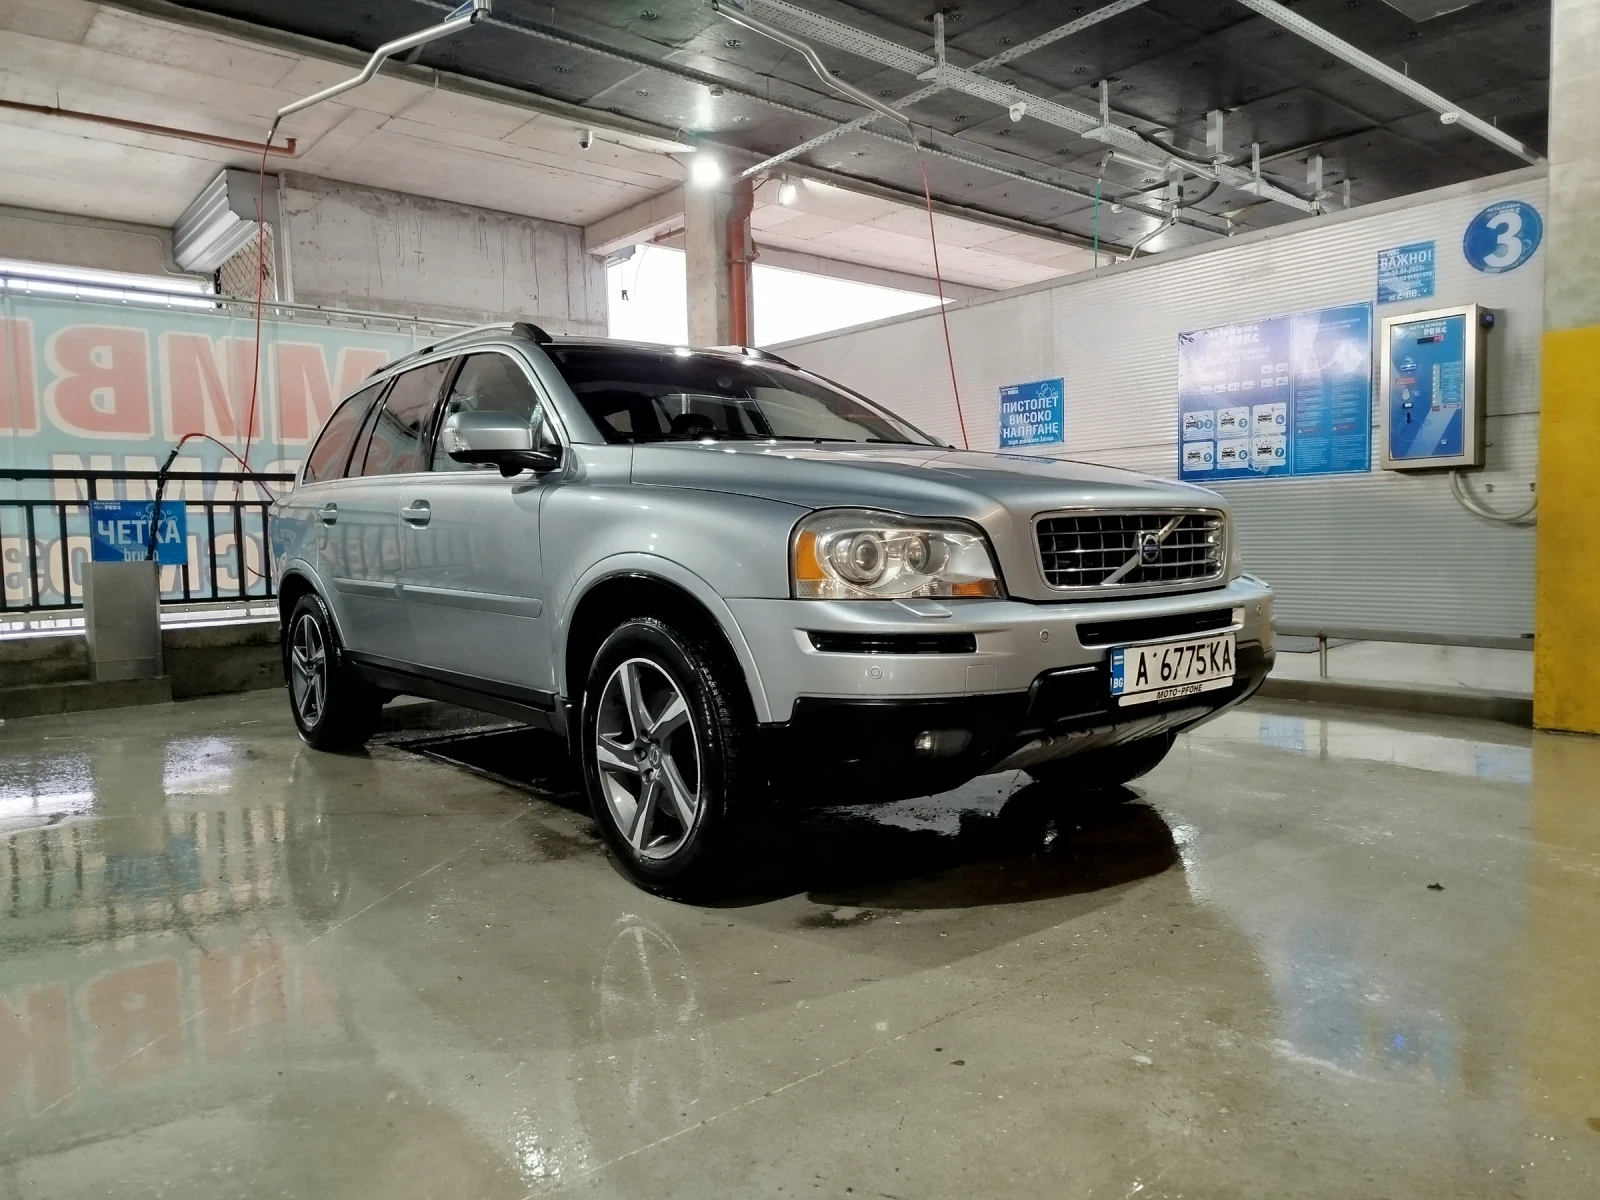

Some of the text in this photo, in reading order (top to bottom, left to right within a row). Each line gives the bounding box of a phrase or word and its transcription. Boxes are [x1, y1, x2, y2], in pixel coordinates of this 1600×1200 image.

[1483, 212, 1523, 267] 3
[1381, 250, 1432, 269] ВАЖНО!
[1397, 290, 1403, 300] 2
[1423, 326, 1447, 335] РЕКС
[1003, 396, 1059, 414] ПИСТОЛЕТ
[1009, 410, 1052, 425] ВИСОКО
[1003, 422, 1059, 439] НАЛЯГАНЕ
[97, 520, 181, 545] ЧЕТКА
[1135, 651, 1149, 686] A
[1113, 677, 1124, 688] BG
[1156, 684, 1203, 699] MOTO-PFOHE
